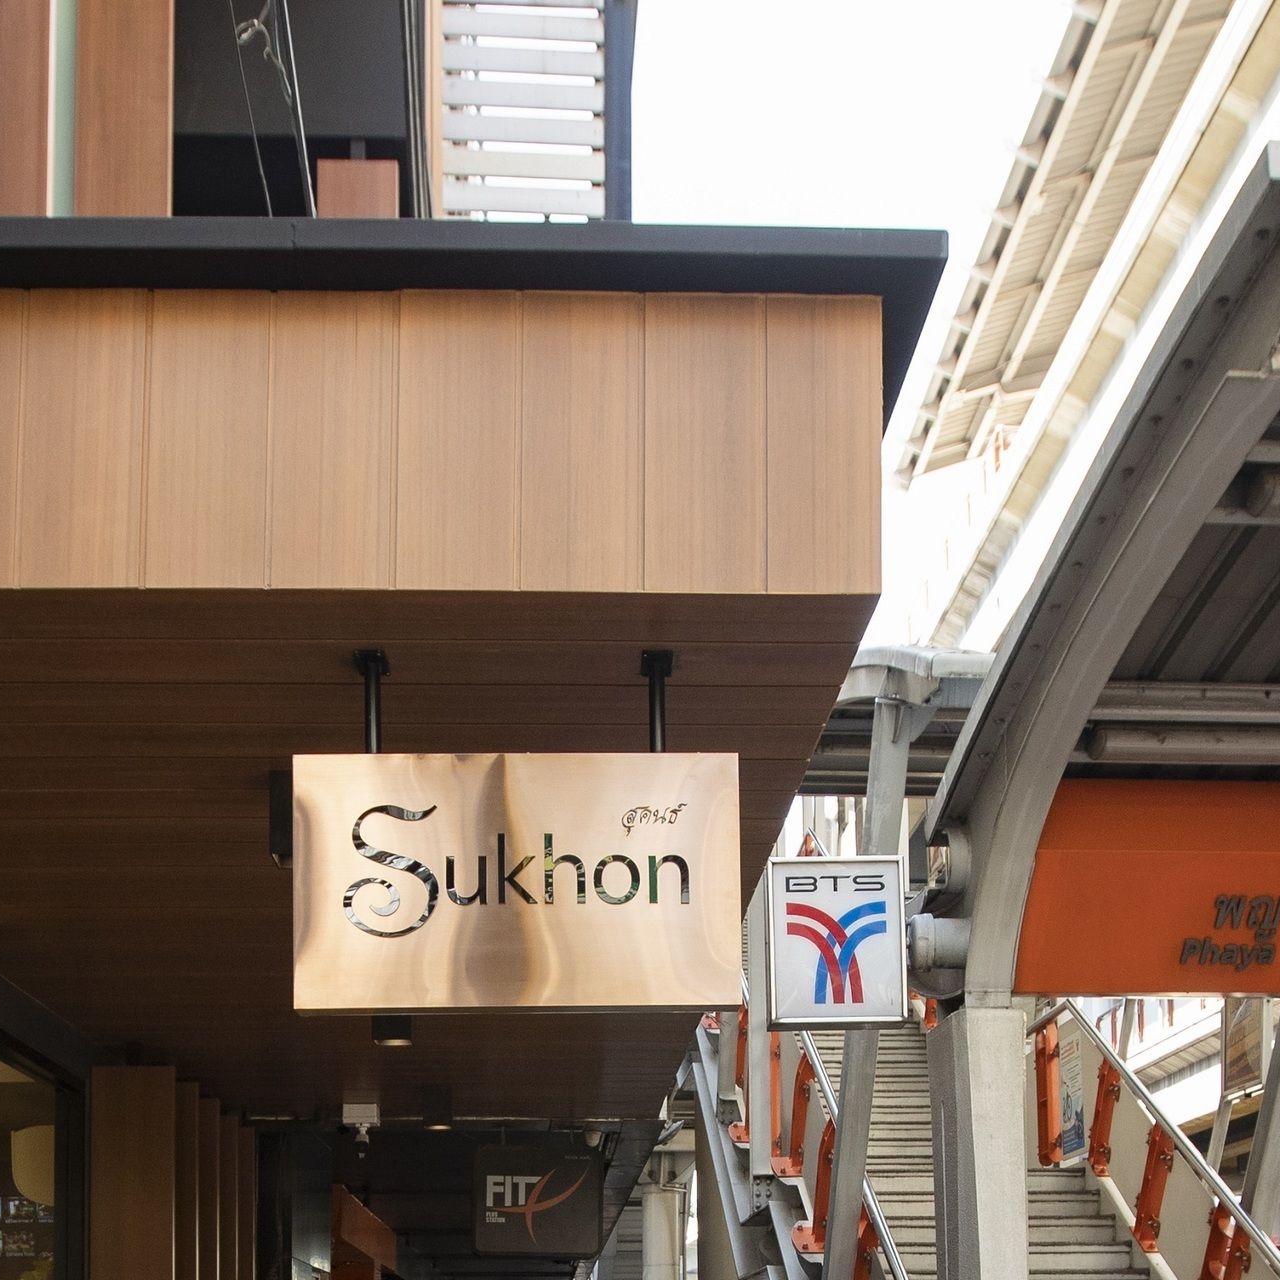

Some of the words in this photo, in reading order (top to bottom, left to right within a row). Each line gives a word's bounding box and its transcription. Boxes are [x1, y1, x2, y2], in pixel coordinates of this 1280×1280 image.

[621, 803, 688, 837] สุคนธ์
[342, 804, 691, 938] Sukhon
[784, 874, 886, 894] BTS
[1179, 937, 1276, 972] Phaya
